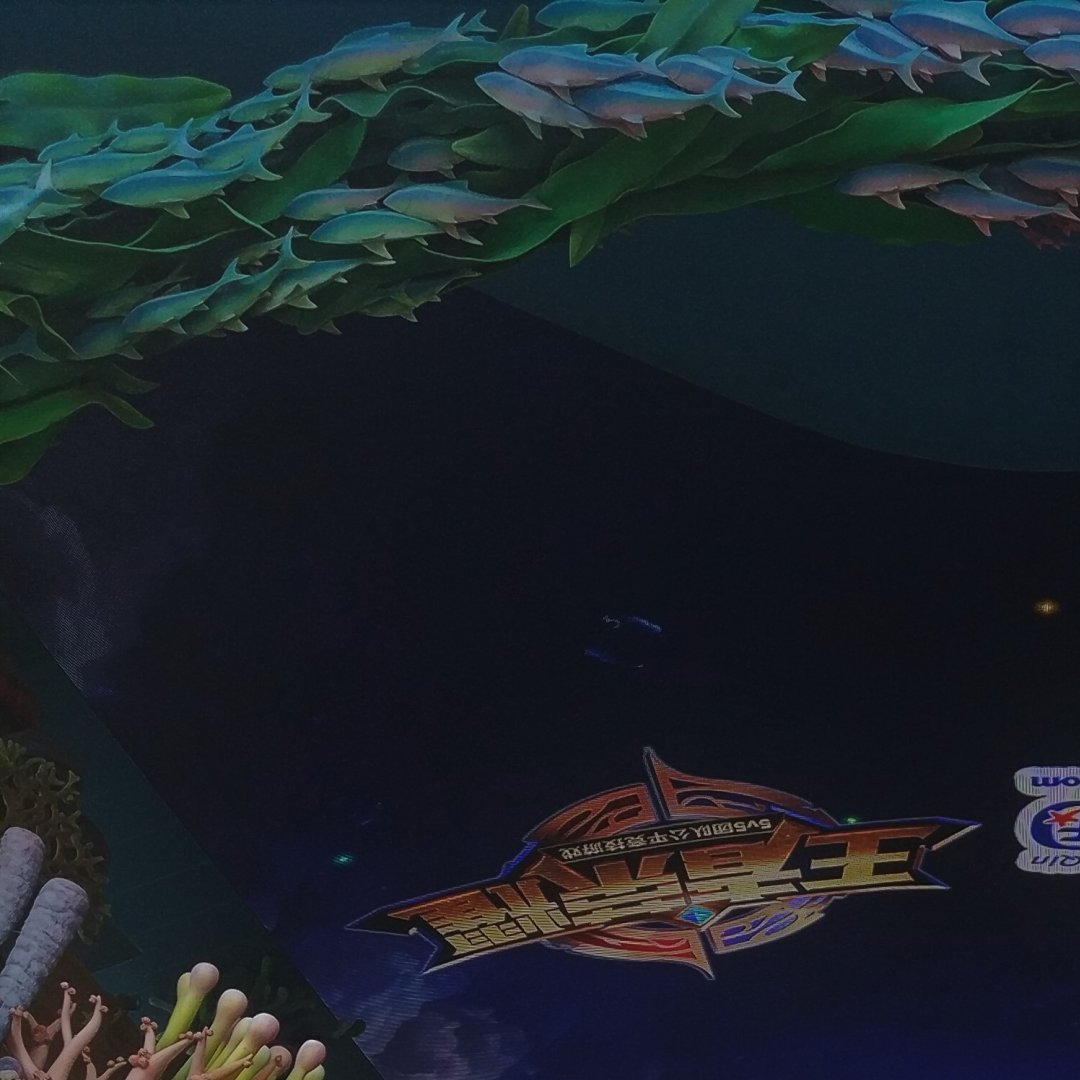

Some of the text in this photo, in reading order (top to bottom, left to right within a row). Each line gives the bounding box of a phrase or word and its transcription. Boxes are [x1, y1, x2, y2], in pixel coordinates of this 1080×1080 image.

[560, 816, 772, 861] 5v5团队公平竞技游戏
